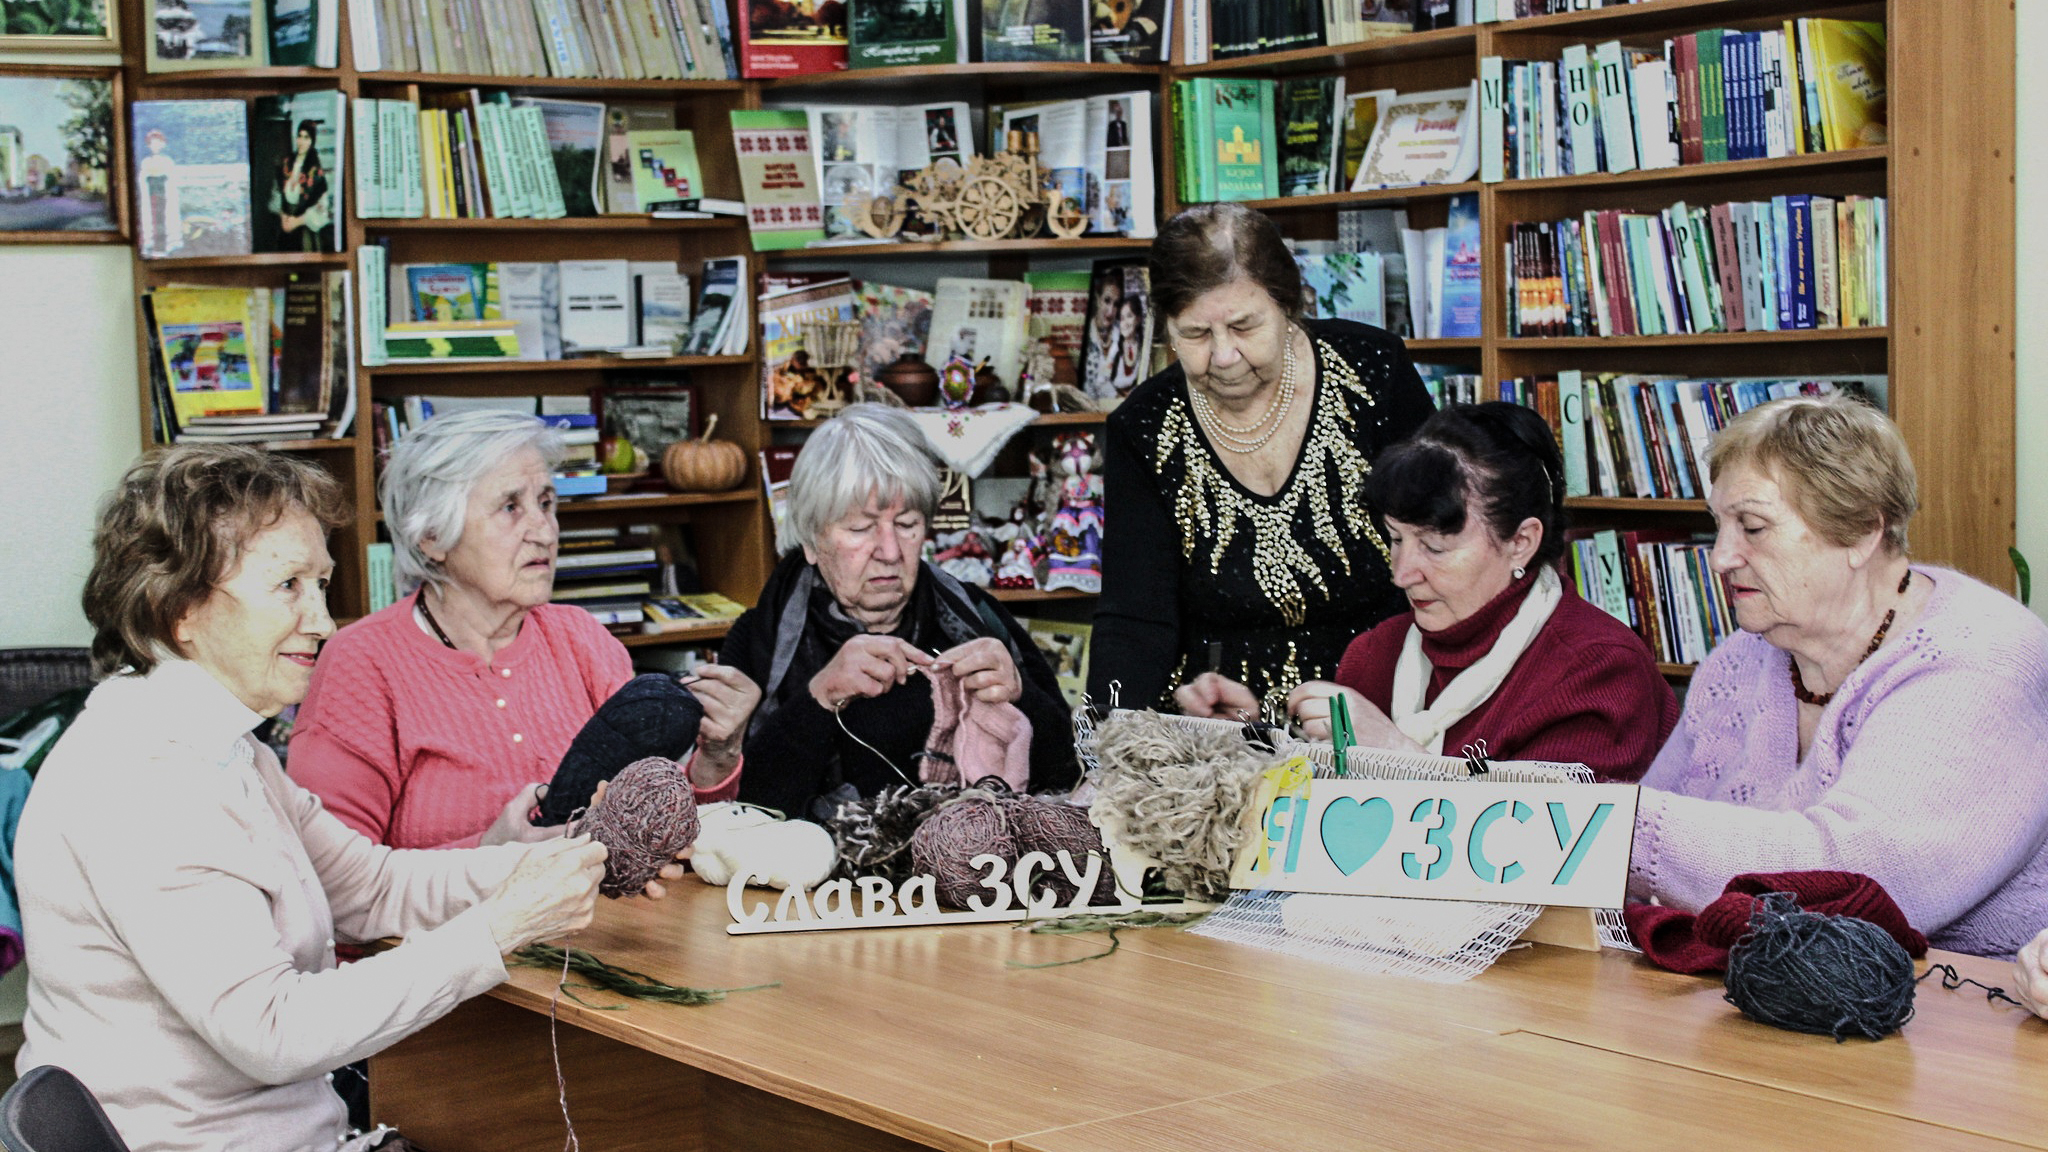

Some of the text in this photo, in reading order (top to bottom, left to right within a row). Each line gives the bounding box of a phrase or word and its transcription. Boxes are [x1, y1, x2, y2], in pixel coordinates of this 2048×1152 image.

[1484, 79, 1501, 110] М
[1569, 68, 1586, 93] Н
[1602, 63, 1621, 96] П
[1573, 101, 1589, 126] О
[1676, 226, 1689, 258] Р
[1563, 394, 1580, 424] С
[1600, 553, 1616, 586] У
[1251, 796, 1615, 885] Я ЗСУ
[726, 852, 1104, 924] Слава ЗСУ
